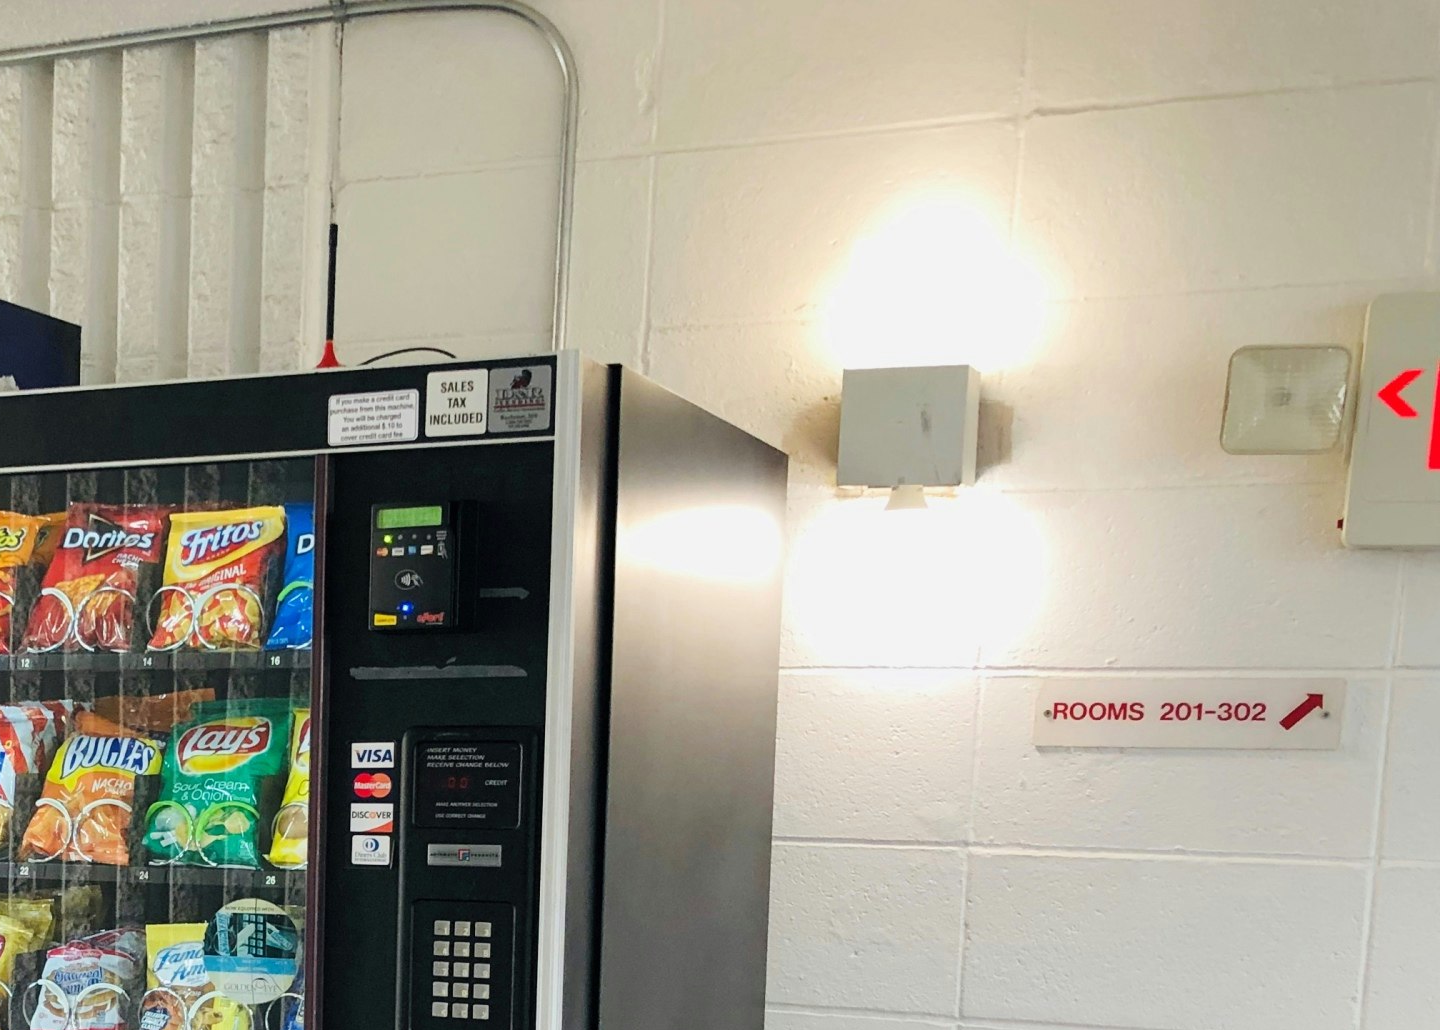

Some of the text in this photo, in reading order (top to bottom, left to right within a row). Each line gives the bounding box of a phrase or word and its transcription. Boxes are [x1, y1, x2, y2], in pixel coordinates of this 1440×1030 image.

[441, 380, 474, 393] SALES
[447, 397, 467, 408] TAX
[429, 412, 483, 425] INCLUDED
[63, 528, 155, 549] Doritos
[181, 519, 264, 567] Fritos
[21, 658, 30, 668] 12
[143, 657, 153, 667] 14
[271, 656, 280, 665] 16
[1052, 702, 1267, 722] ROOMS 201-302
[182, 726, 267, 761] Lay's
[60, 735, 157, 780] BUGLES
[356, 749, 393, 762] VISA
[91, 777, 132, 793] NACHO
[172, 778, 250, 794] Sour Cream
[181, 788, 232, 802] & Onion
[351, 811, 392, 819] DISCOVER
[20, 866, 29, 876] 22
[139, 871, 149, 880] 24
[265, 875, 276, 885] 26
